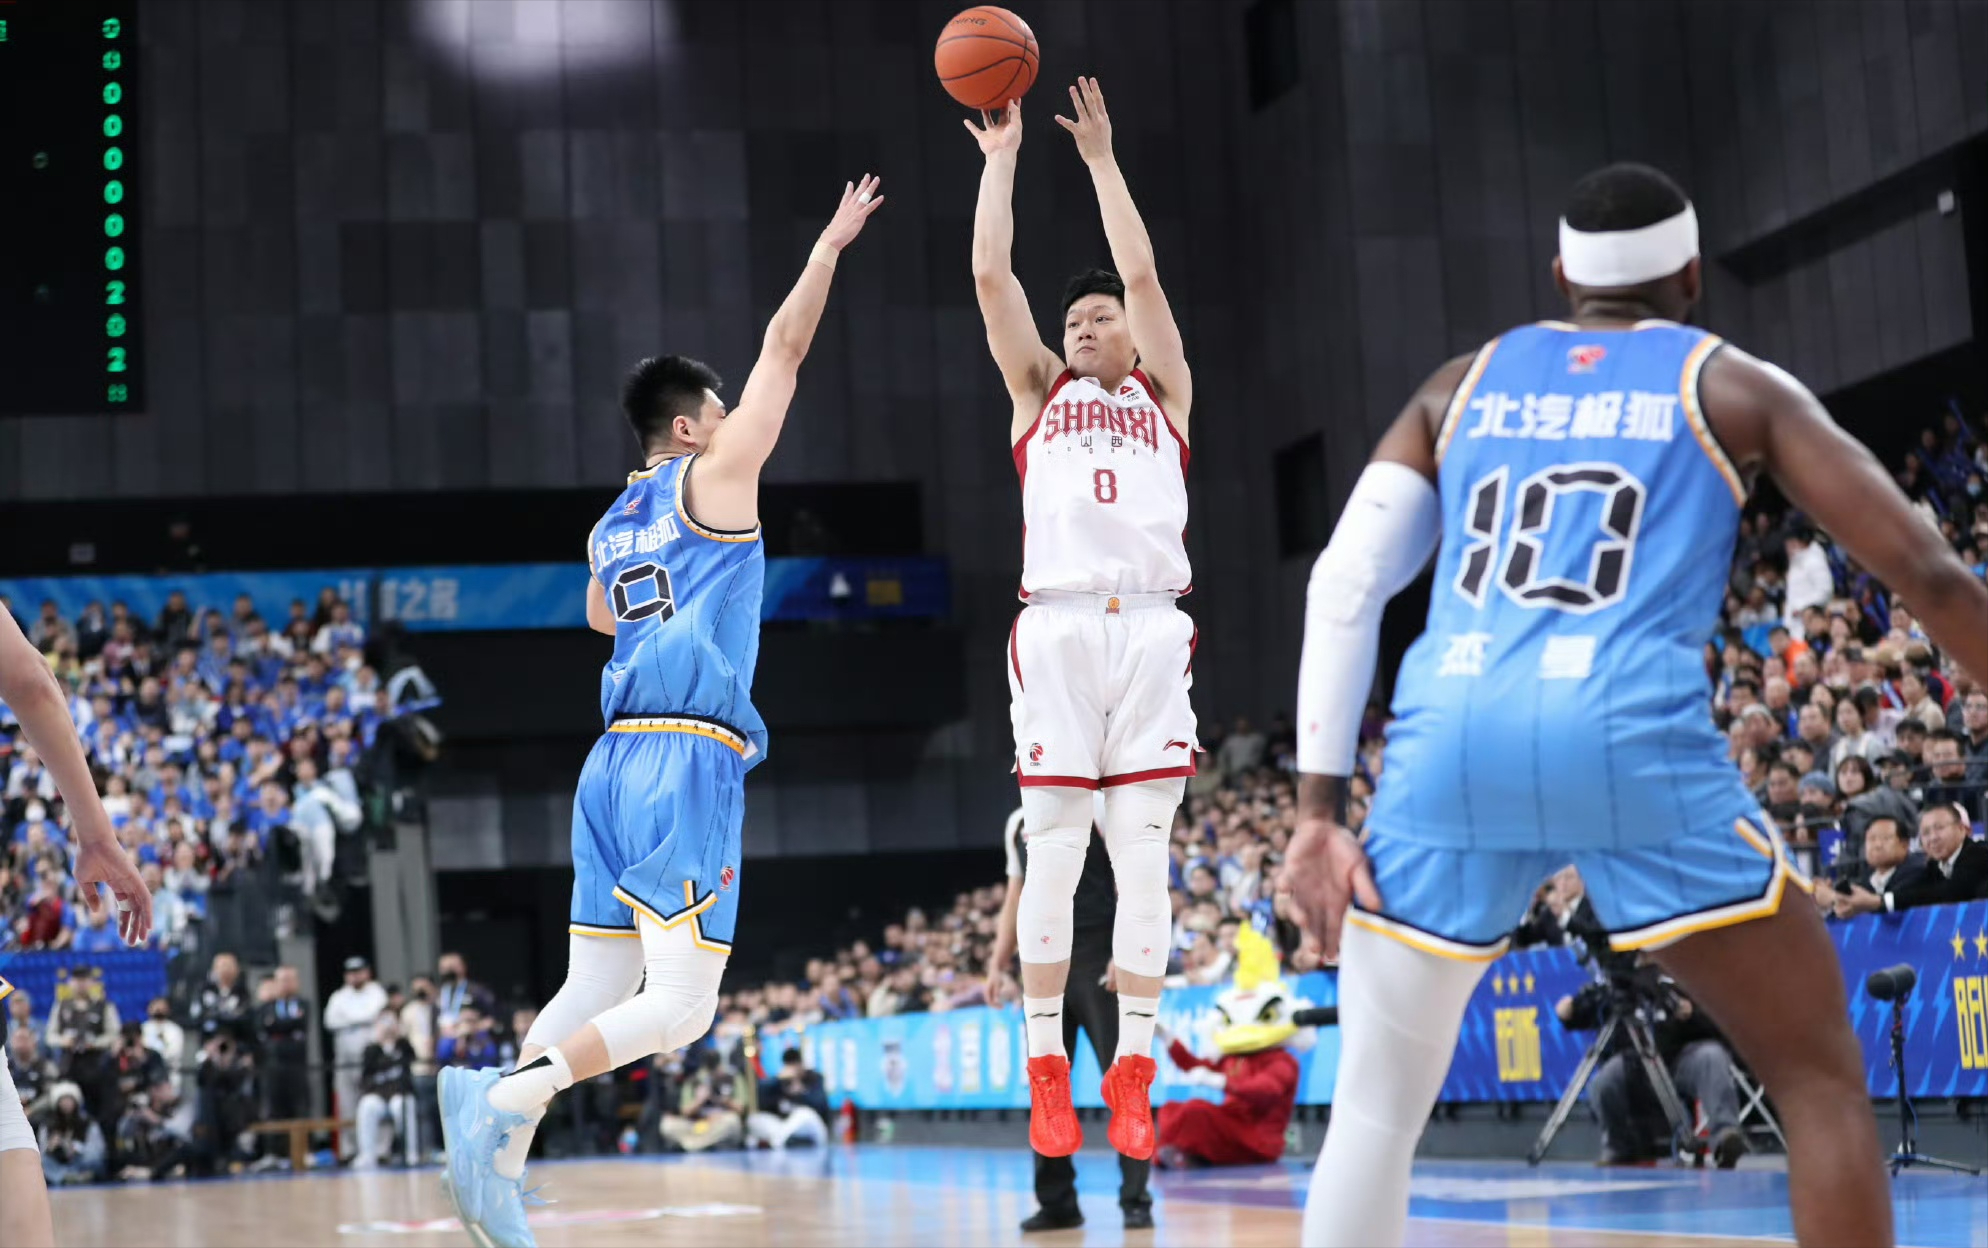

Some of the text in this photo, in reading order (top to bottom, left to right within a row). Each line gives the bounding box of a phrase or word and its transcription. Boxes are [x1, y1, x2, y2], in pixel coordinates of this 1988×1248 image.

[103, 82, 122, 104] 0
[103, 114, 123, 138] 0
[103, 147, 123, 171] 0
[104, 180, 124, 204] 0
[104, 213, 124, 238] 0
[105, 246, 125, 271] 0
[106, 280, 126, 305] 2
[107, 347, 127, 372] 2
[1043, 398, 1159, 453] SHANXI
[1467, 390, 1680, 441] 北汽极狐
[1081, 436, 1123, 447] 山西
[1093, 468, 1118, 503] 8
[1453, 462, 1647, 615] 10
[611, 561, 677, 625] 9
[1953, 974, 1988, 1069] BEI
